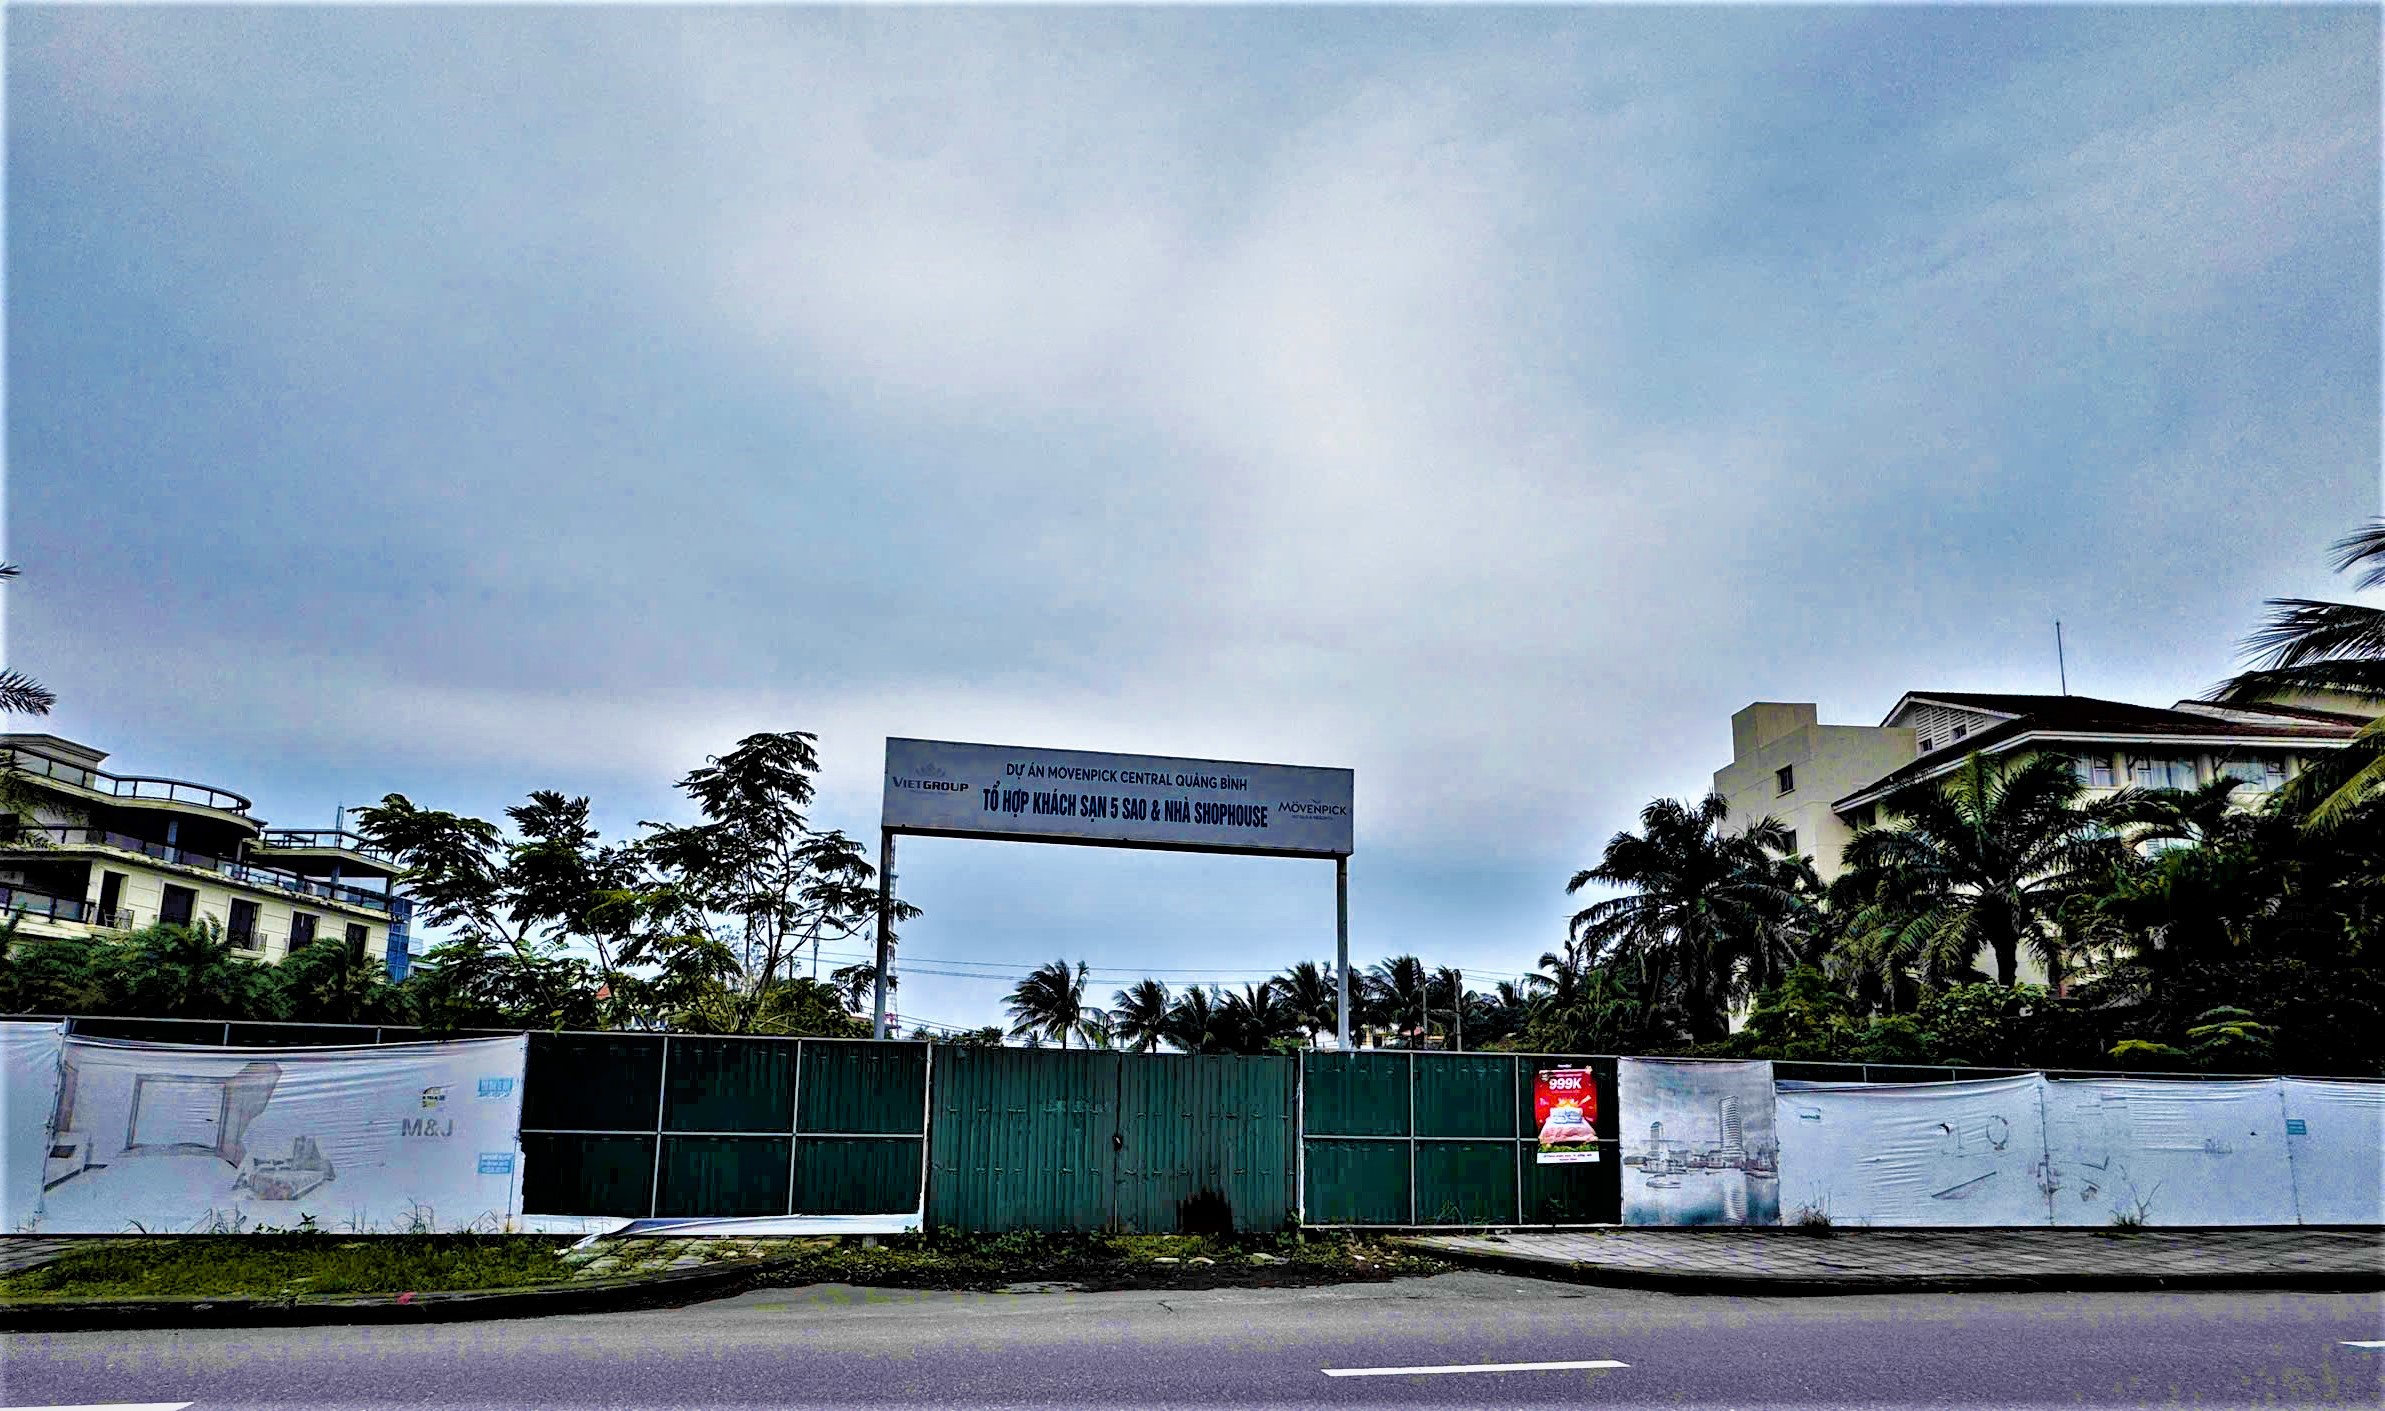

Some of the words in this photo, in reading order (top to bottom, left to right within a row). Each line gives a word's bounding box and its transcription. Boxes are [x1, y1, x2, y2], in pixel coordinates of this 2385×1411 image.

[1006, 763, 1026, 780] DỰ
[1028, 762, 1045, 778] ÁN
[1047, 766, 1118, 783] MOVENPICK
[1120, 771, 1173, 786] CENTRAL
[1220, 774, 1248, 791] BÌNH
[983, 780, 1000, 812] TỔ
[1003, 789, 1029, 818] HỢP
[1033, 788, 1077, 817] KHÁCH
[1080, 795, 1107, 822] SẠN
[1110, 797, 1118, 819] 5
[1122, 797, 1147, 821] SAO
[1150, 799, 1160, 821] &
[1164, 796, 1191, 823] NHÀ
[1194, 801, 1268, 828] SHOPHOUSE
[1278, 800, 1347, 816] MÖVENPICK
[1549, 1077, 1582, 1090] 999K
